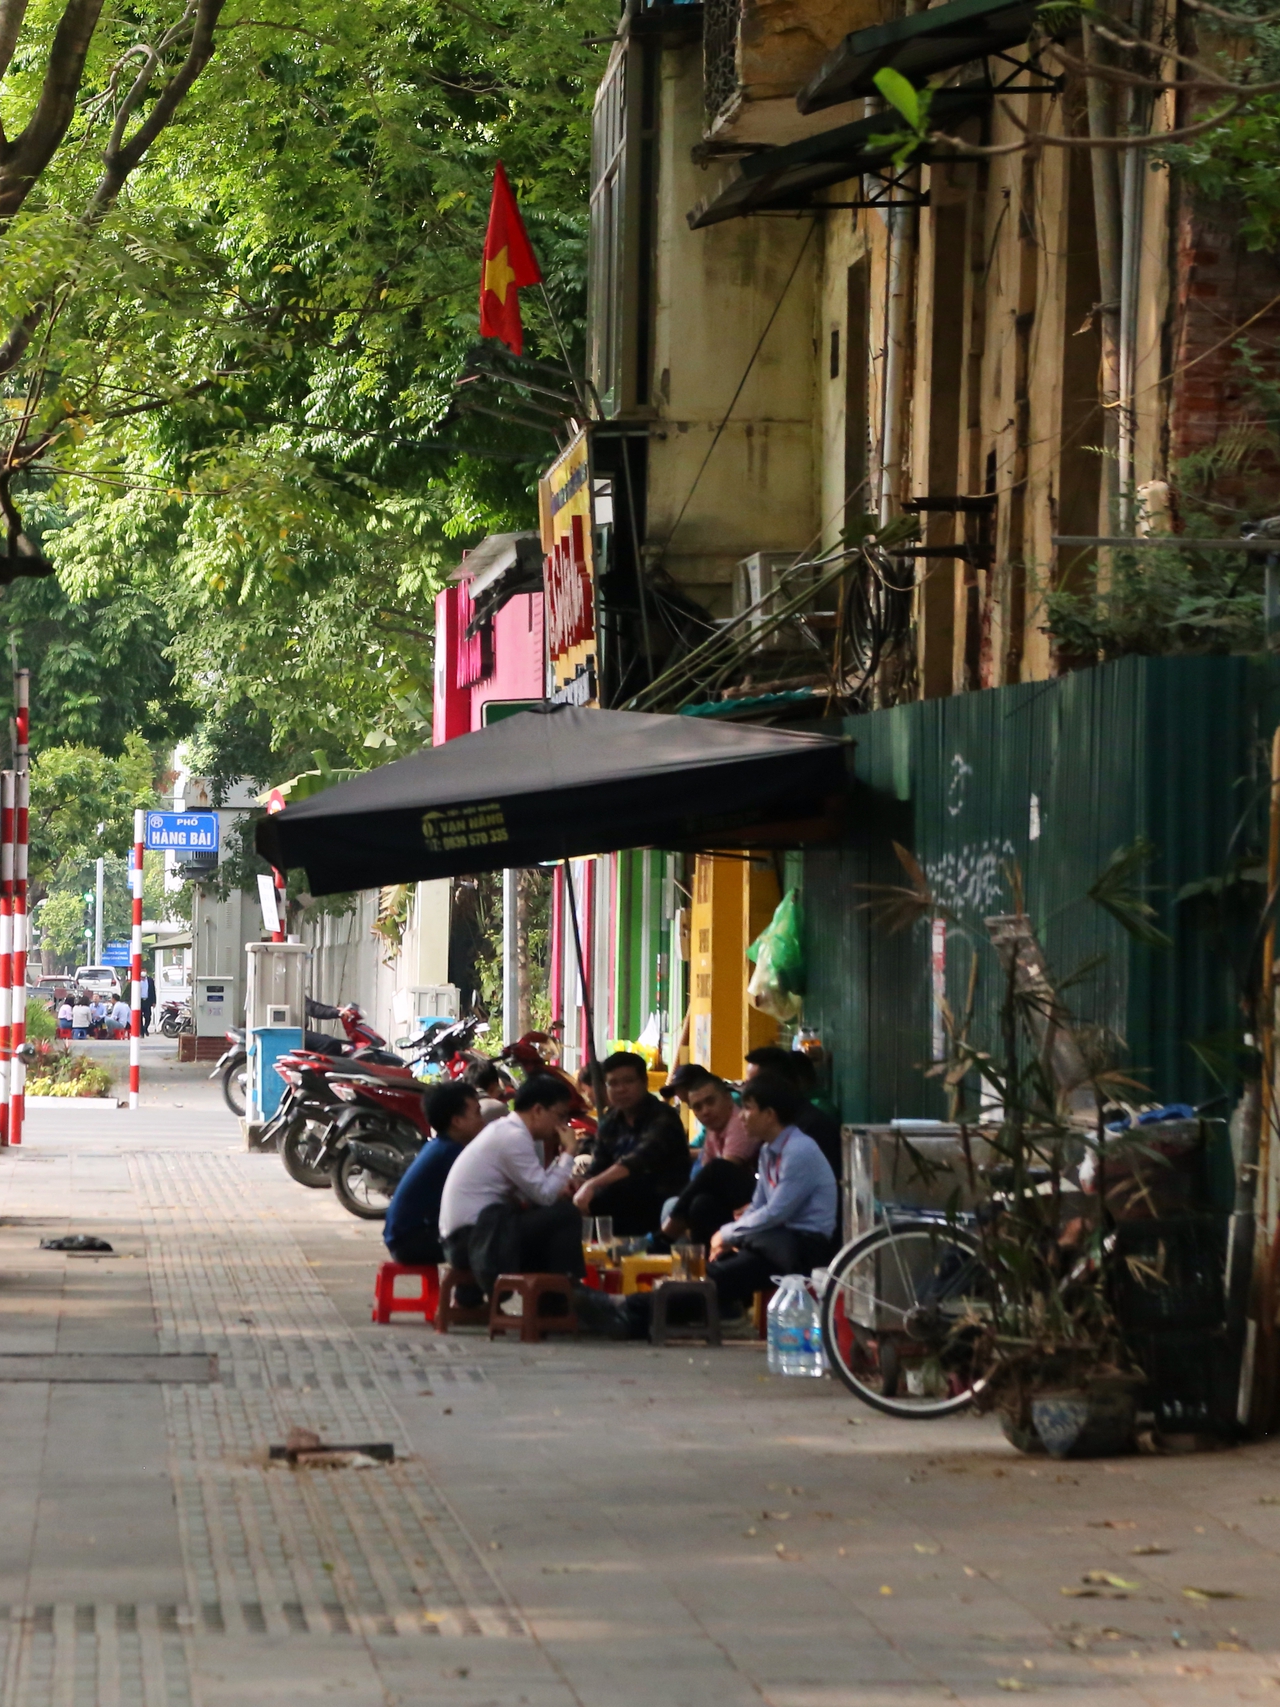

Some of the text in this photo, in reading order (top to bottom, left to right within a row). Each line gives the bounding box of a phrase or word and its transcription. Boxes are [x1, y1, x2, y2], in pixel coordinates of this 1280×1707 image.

[176, 815, 199, 826] PHỐ
[152, 828, 211, 846] HÀNG BÀI
